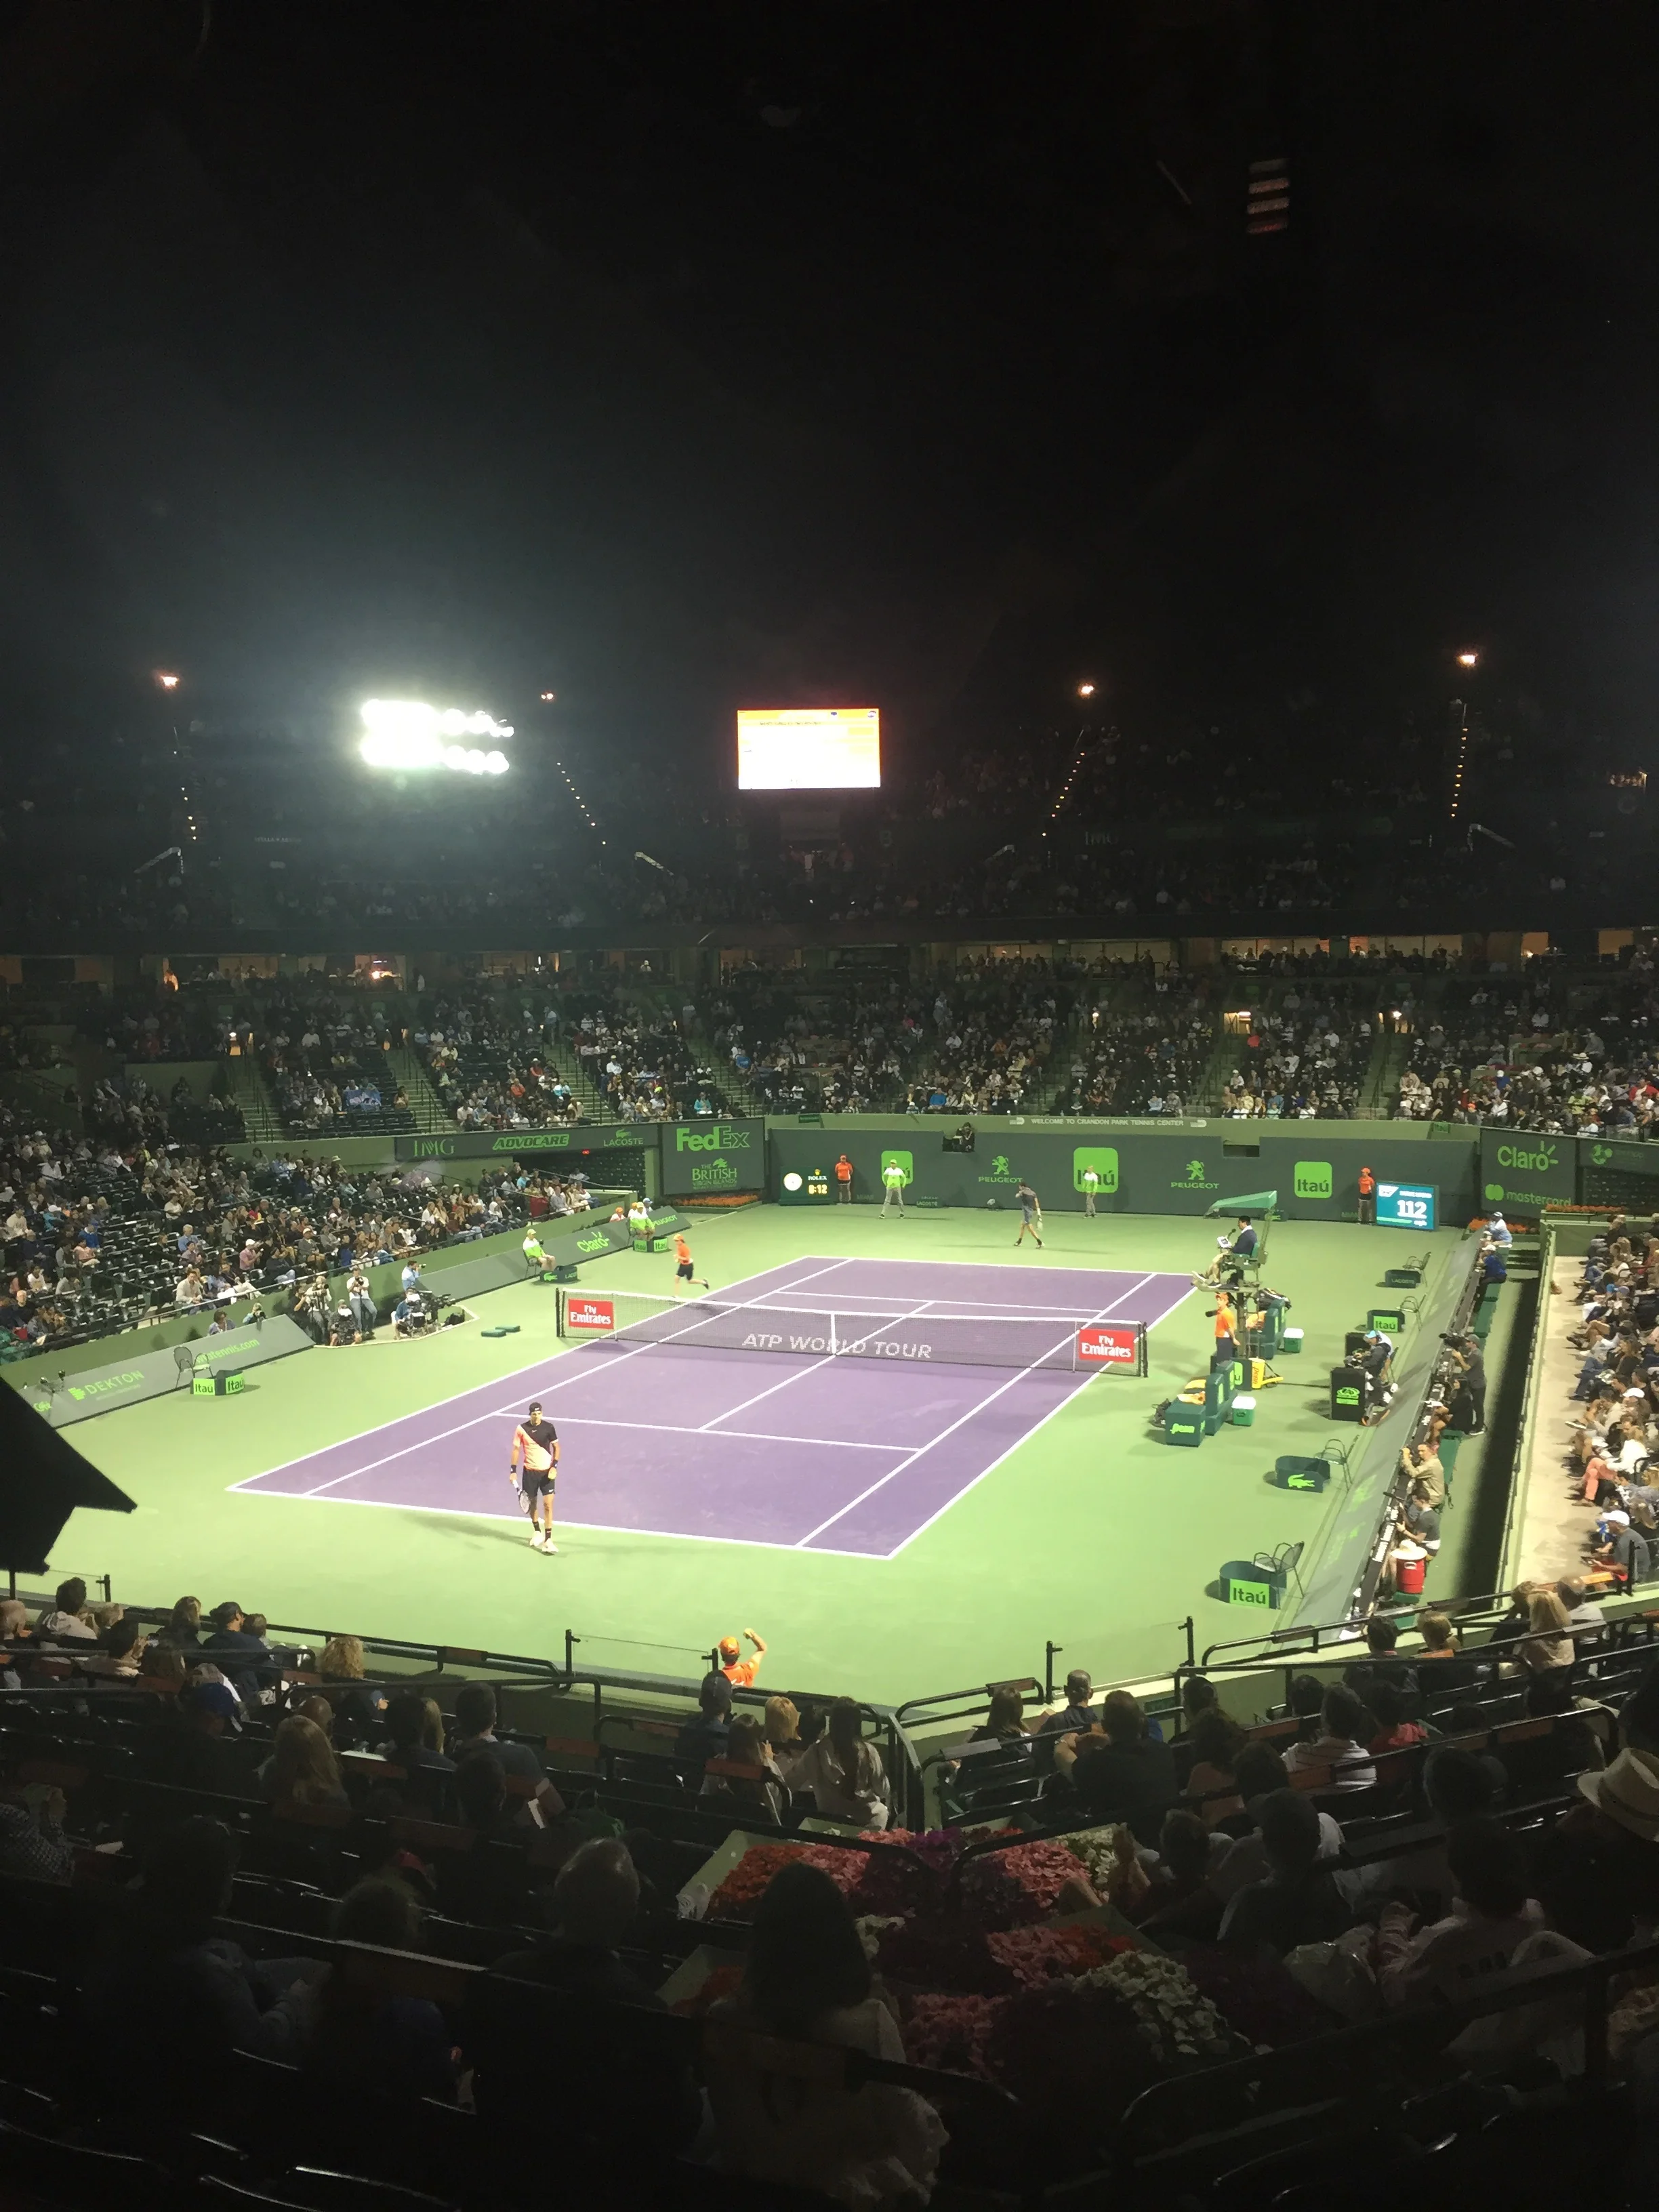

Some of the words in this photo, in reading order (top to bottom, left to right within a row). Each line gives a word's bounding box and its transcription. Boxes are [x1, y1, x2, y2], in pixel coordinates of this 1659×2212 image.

[493, 1134, 569, 1150] ADVOCARE
[603, 1138, 643, 1147] LACOSTE
[676, 1126, 750, 1151] FedEx
[413, 1139, 455, 1157] IMG
[1497, 1144, 1549, 1171] Claro
[692, 1167, 737, 1181] BRITISH
[978, 1176, 1023, 1184] PEUGEOT
[1297, 1179, 1329, 1193] Itaú
[1507, 1189, 1572, 1207] mastercard
[1397, 1200, 1427, 1219] 112
[577, 1236, 609, 1252] Claro
[584, 1305, 596, 1314] Fly
[570, 1311, 611, 1325] Emirates
[1375, 1320, 1396, 1330] Itaú
[742, 1333, 782, 1348] ATP
[790, 1335, 866, 1354] WORLD
[874, 1340, 932, 1358] TOUR
[1099, 1335, 1114, 1346] Fly
[1081, 1342, 1132, 1358] Emirates
[84, 1370, 145, 1395] DEKTON
[195, 1382, 213, 1393] Itaú
[1233, 1586, 1266, 1605] Itaú
